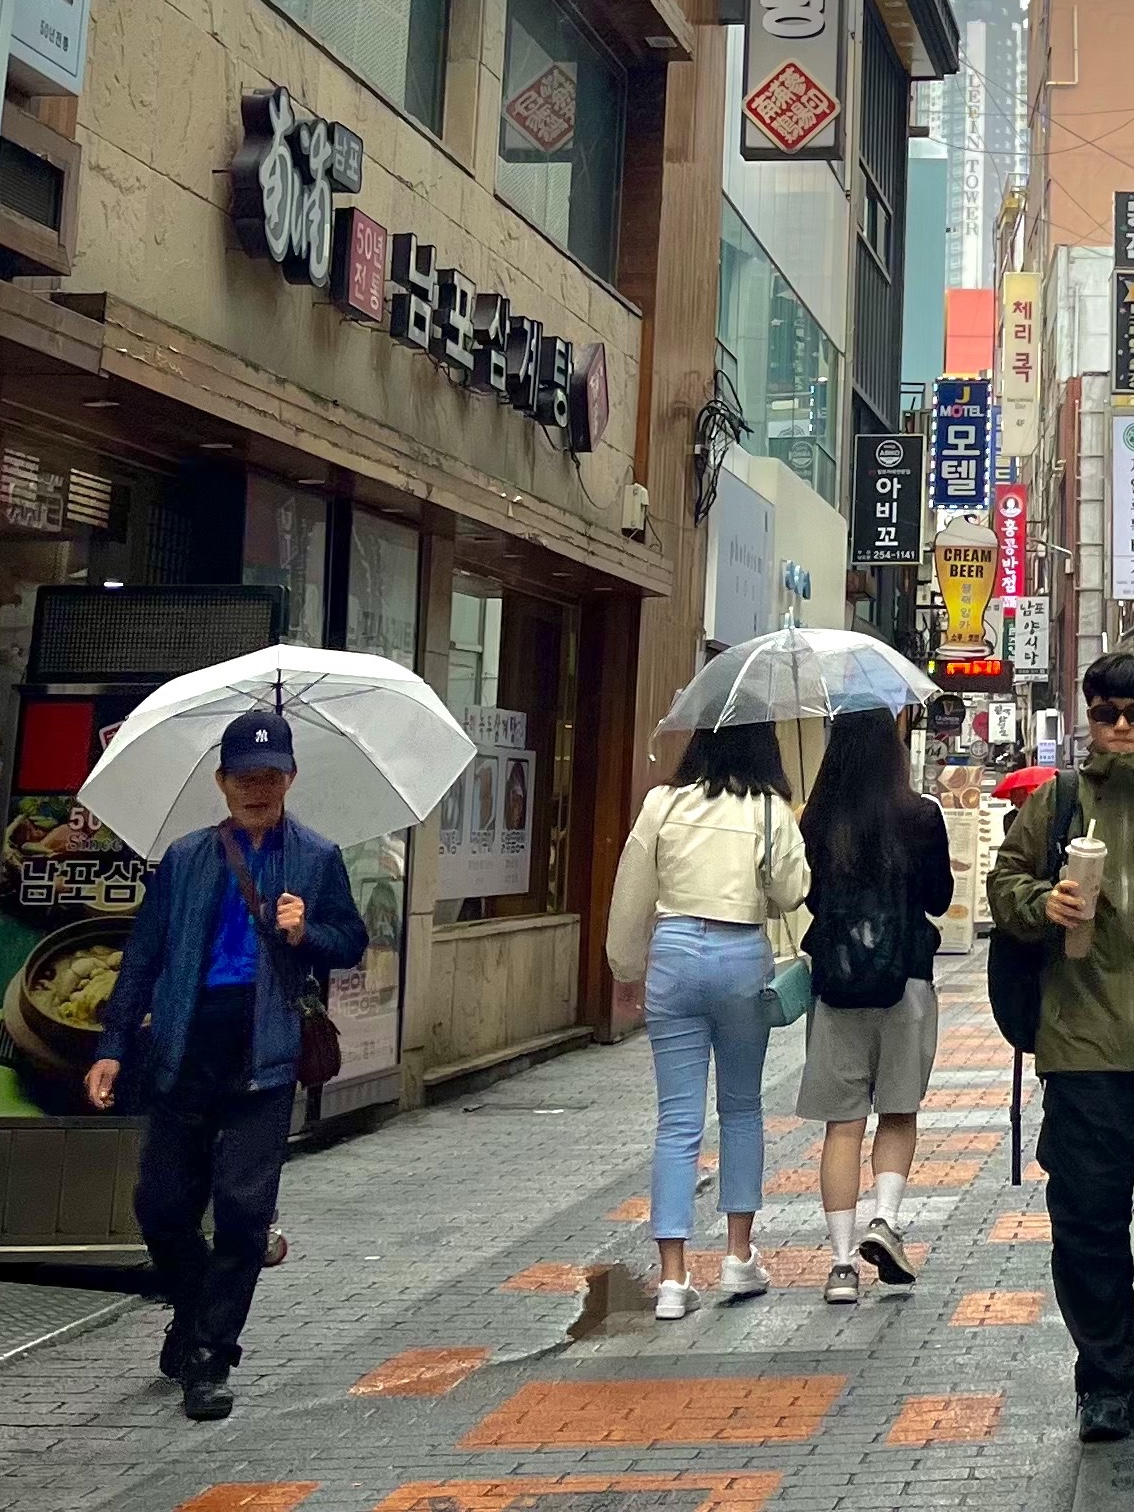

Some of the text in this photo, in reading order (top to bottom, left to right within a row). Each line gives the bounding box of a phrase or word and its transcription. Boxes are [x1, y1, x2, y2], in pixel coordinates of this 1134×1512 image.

[333, 136, 359, 182] 남포
[966, 159, 980, 236] TOWER
[356, 221, 383, 269] 50년
[354, 262, 380, 310] 전통
[390, 232, 573, 428] 남포삼계탕
[1012, 300, 1033, 383] 체리콕
[940, 405, 984, 418] MOTEL
[955, 386, 970, 403] J
[941, 425, 981, 495] 모텔
[875, 477, 901, 546] 아비꼬
[873, 550, 915, 560] 254-1141
[944, 548, 992, 563] CREAM
[950, 564, 984, 578] BEER
[1001, 519, 1019, 593] 홍콩반점
[20, 859, 158, 906] 남포삼
